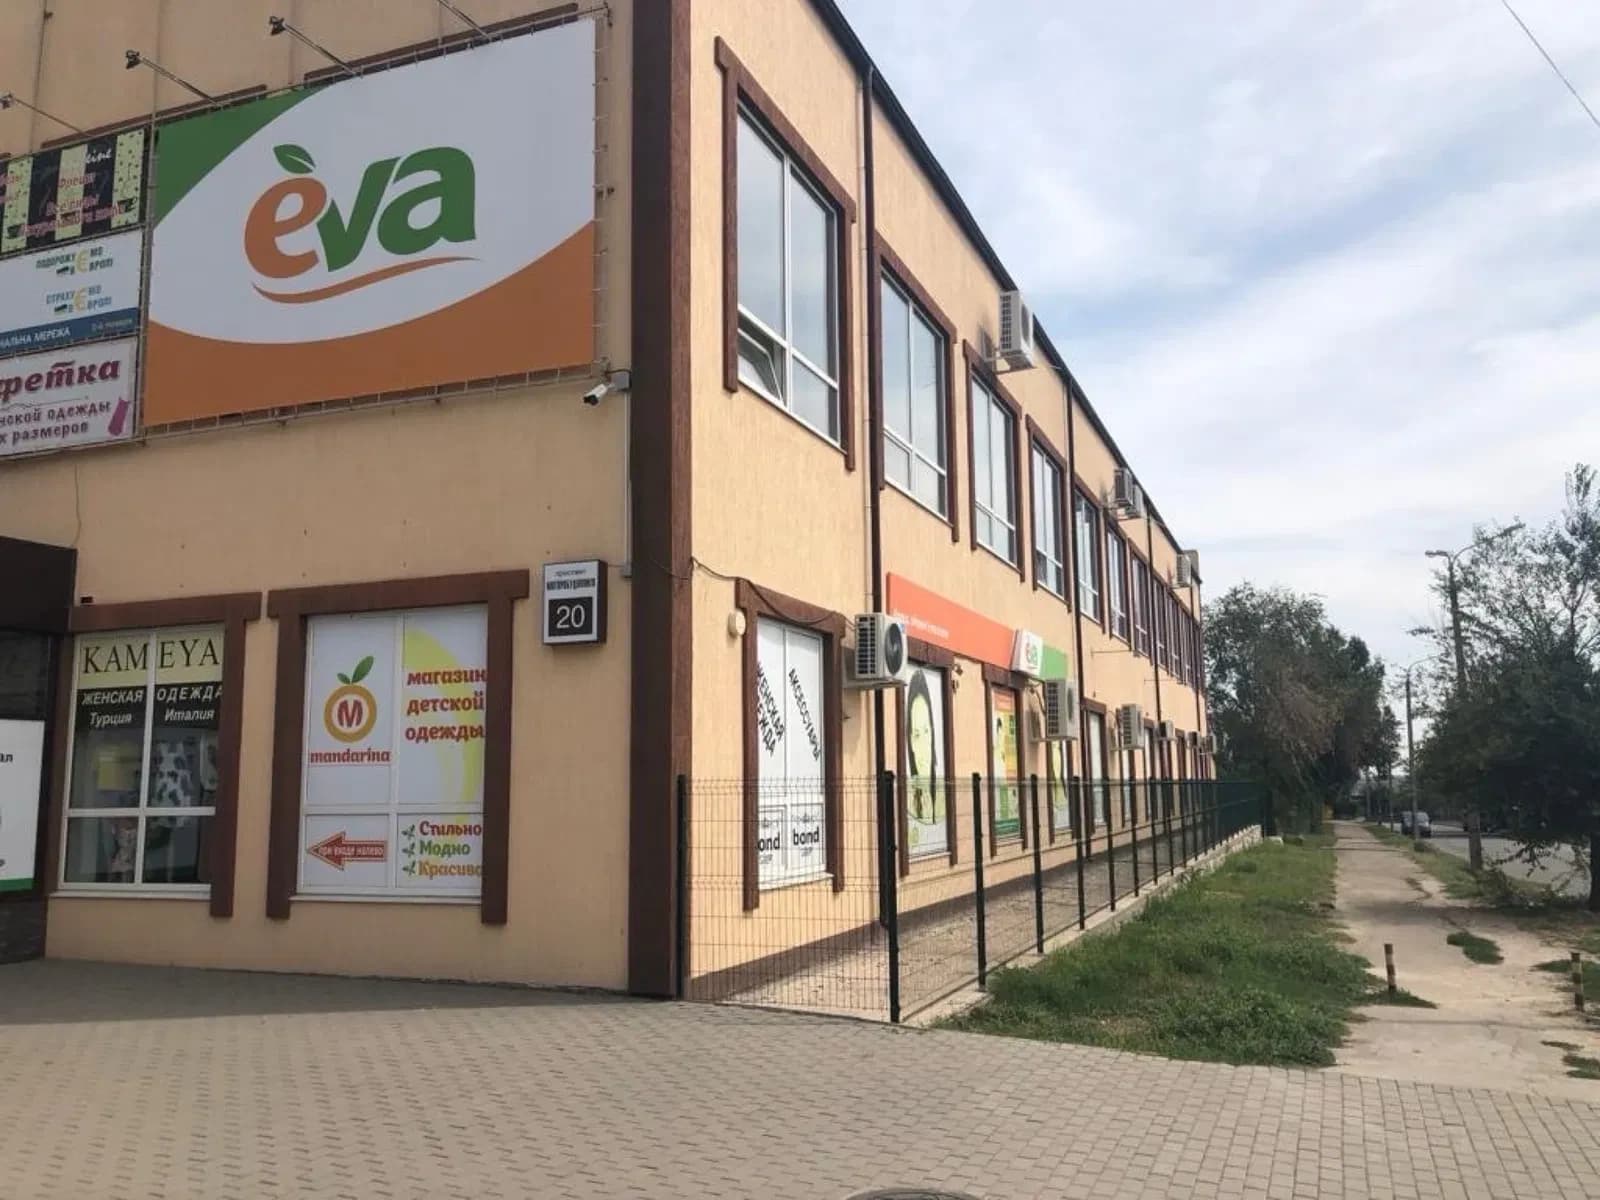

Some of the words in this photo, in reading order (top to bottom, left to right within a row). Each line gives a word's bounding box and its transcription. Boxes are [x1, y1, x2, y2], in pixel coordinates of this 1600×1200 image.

[12, 422, 88, 445] размеров
[556, 604, 585, 629] 20
[83, 640, 220, 674] KAMEYA
[407, 668, 487, 685] магазин
[81, 690, 144, 705] ЖЕНСКАЯ
[407, 690, 485, 716] детской
[90, 712, 132, 728] Турция
[165, 708, 215, 721] Италия
[405, 724, 486, 743] одежды
[309, 748, 391, 763] mandarina
[419, 820, 482, 837] Стильно
[793, 825, 819, 846] bond
[419, 840, 471, 858] Модно
[757, 831, 780, 852] ond
